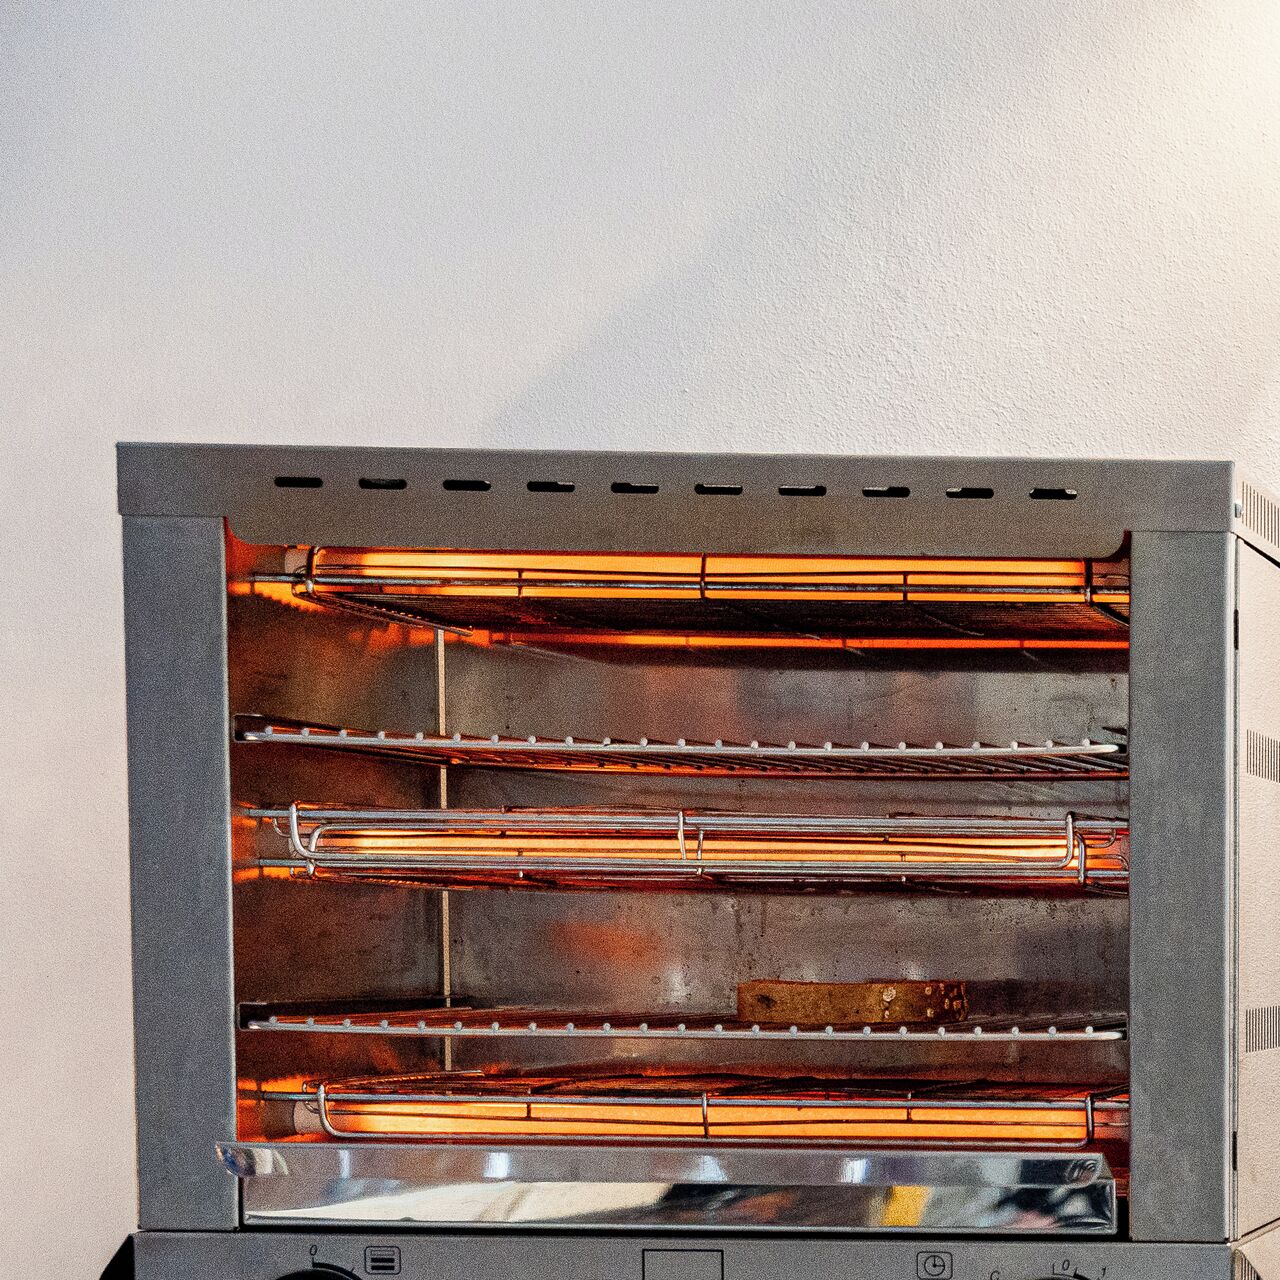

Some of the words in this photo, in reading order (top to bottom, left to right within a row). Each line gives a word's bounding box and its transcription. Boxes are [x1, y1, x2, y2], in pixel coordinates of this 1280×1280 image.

[309, 1244, 318, 1256] 0
[1061, 1259, 1070, 1271] 0
[1101, 1267, 1107, 1277] 1
